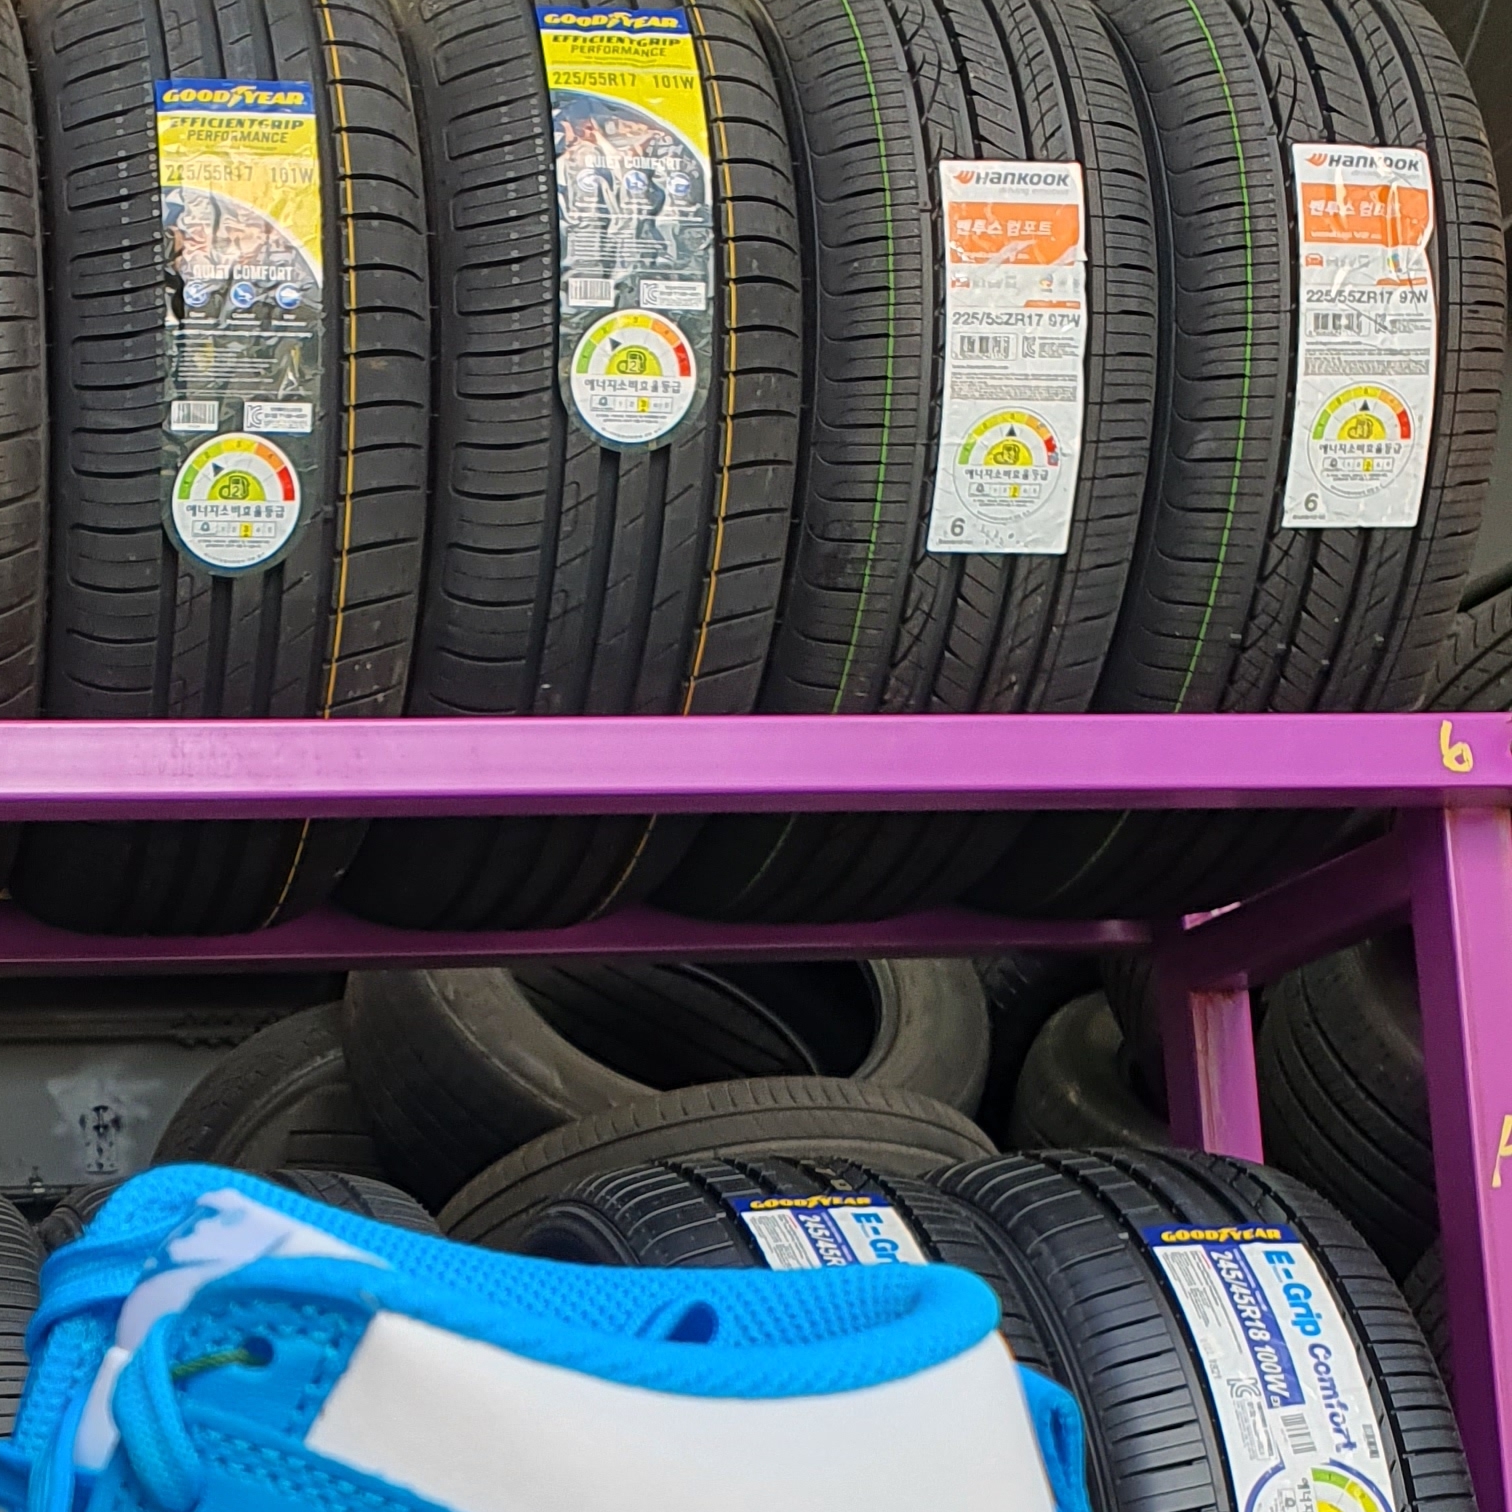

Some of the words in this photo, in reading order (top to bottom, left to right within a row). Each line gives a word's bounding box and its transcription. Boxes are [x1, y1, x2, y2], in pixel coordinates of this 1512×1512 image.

[544, 12, 680, 29] GOODYEAR
[552, 35, 681, 47] EFFICIENTGRIP
[571, 45, 667, 58] PERFORMANCE
[553, 71, 637, 87] 225/55R17
[652, 74, 694, 90] 101W
[162, 86, 305, 107] GOODYEAR
[170, 117, 304, 130] EFFICIENTGRIP
[188, 130, 289, 144] PERFORMANCE
[166, 164, 253, 182] 225/55R17
[271, 167, 314, 184] 101W
[233, 265, 295, 281] COMFORT
[1399, 290, 1428, 304] 97W
[1049, 313, 1080, 328] 97W
[1304, 492, 1319, 512] 6
[950, 517, 966, 537] 6
[1440, 719, 1474, 773] 6
[750, 1195, 871, 1209] GOODYEAR
[1161, 1228, 1281, 1242] GOODYEAR
[1210, 1251, 1271, 1342] 245/45R18
[1254, 1345, 1290, 1399] 100W
[1262, 1250, 1323, 1337] E-Grip
[1307, 1343, 1357, 1453] Comfort
